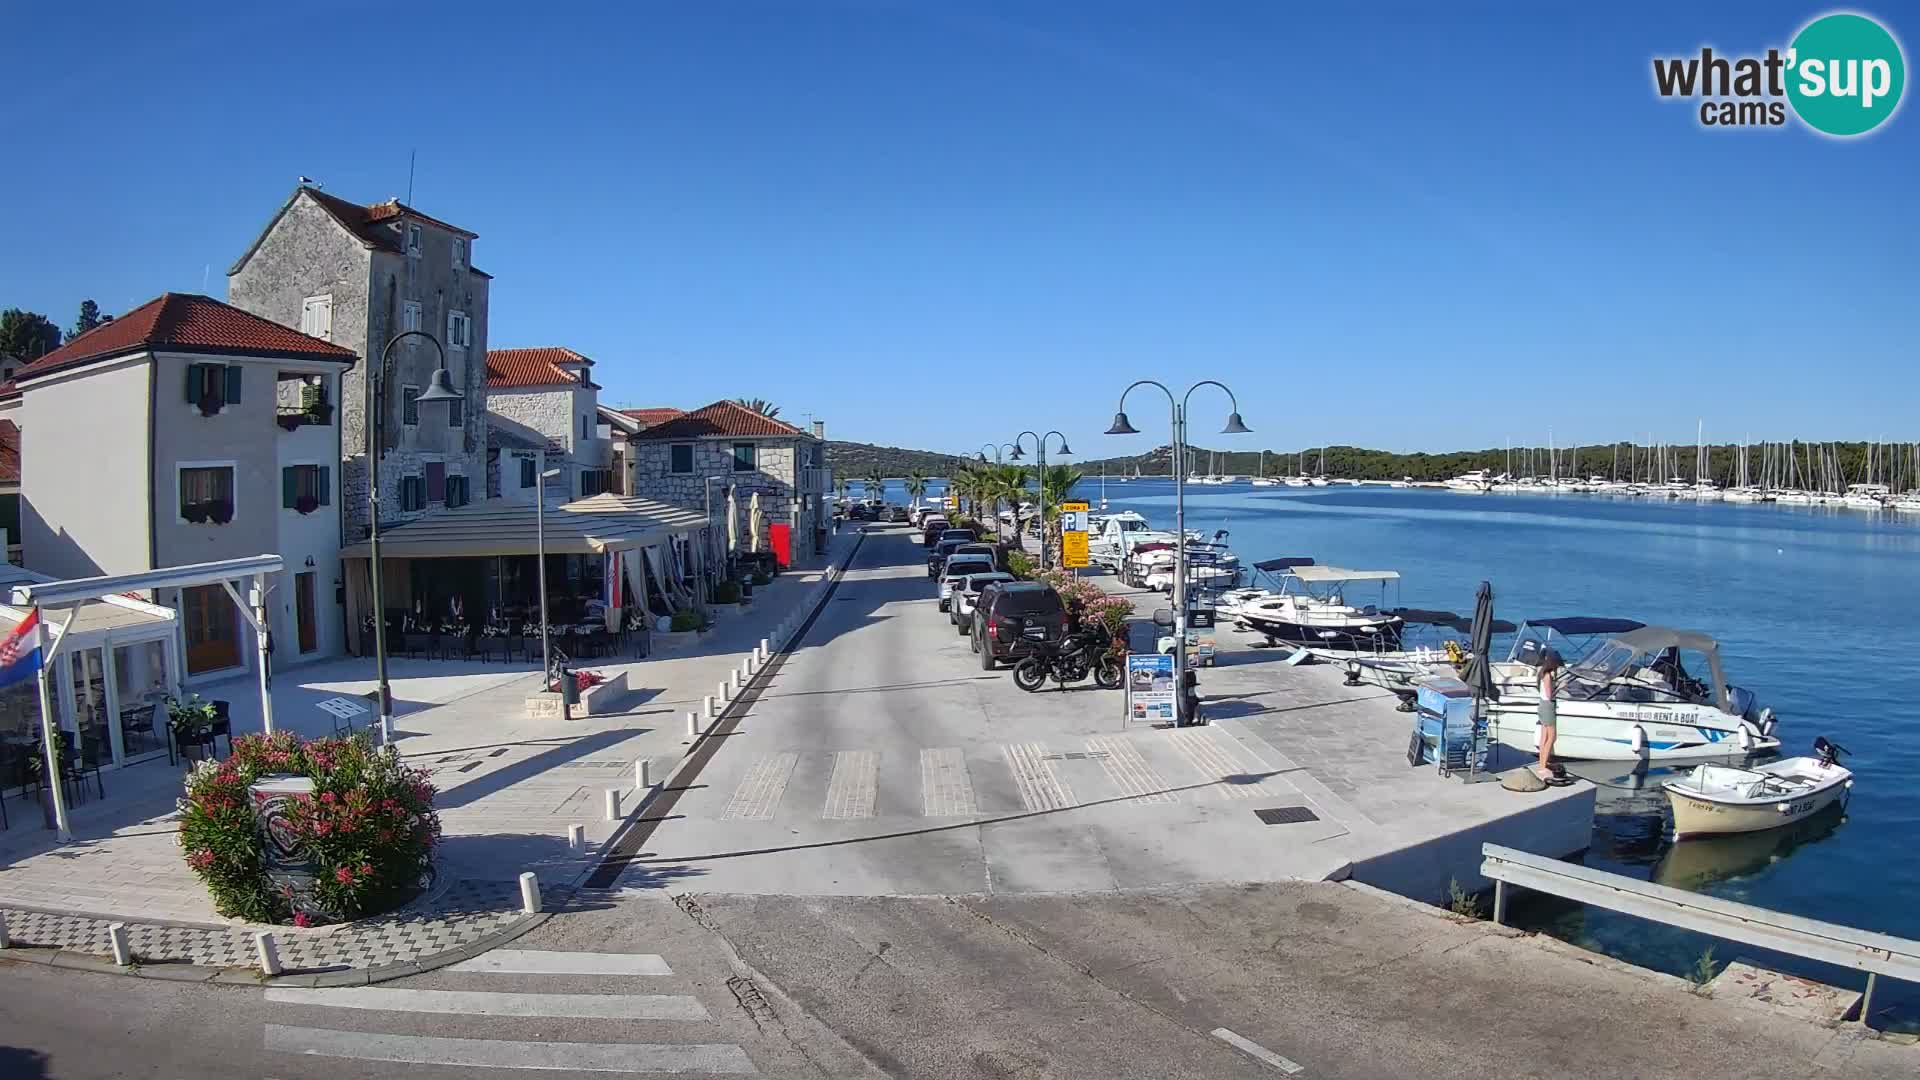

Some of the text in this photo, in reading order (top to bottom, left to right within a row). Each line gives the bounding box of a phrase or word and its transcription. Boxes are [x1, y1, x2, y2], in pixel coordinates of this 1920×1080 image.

[1653, 711, 1673, 721] RENT
[1674, 712, 1680, 721] A
[1680, 713, 1699, 725] BOAT
